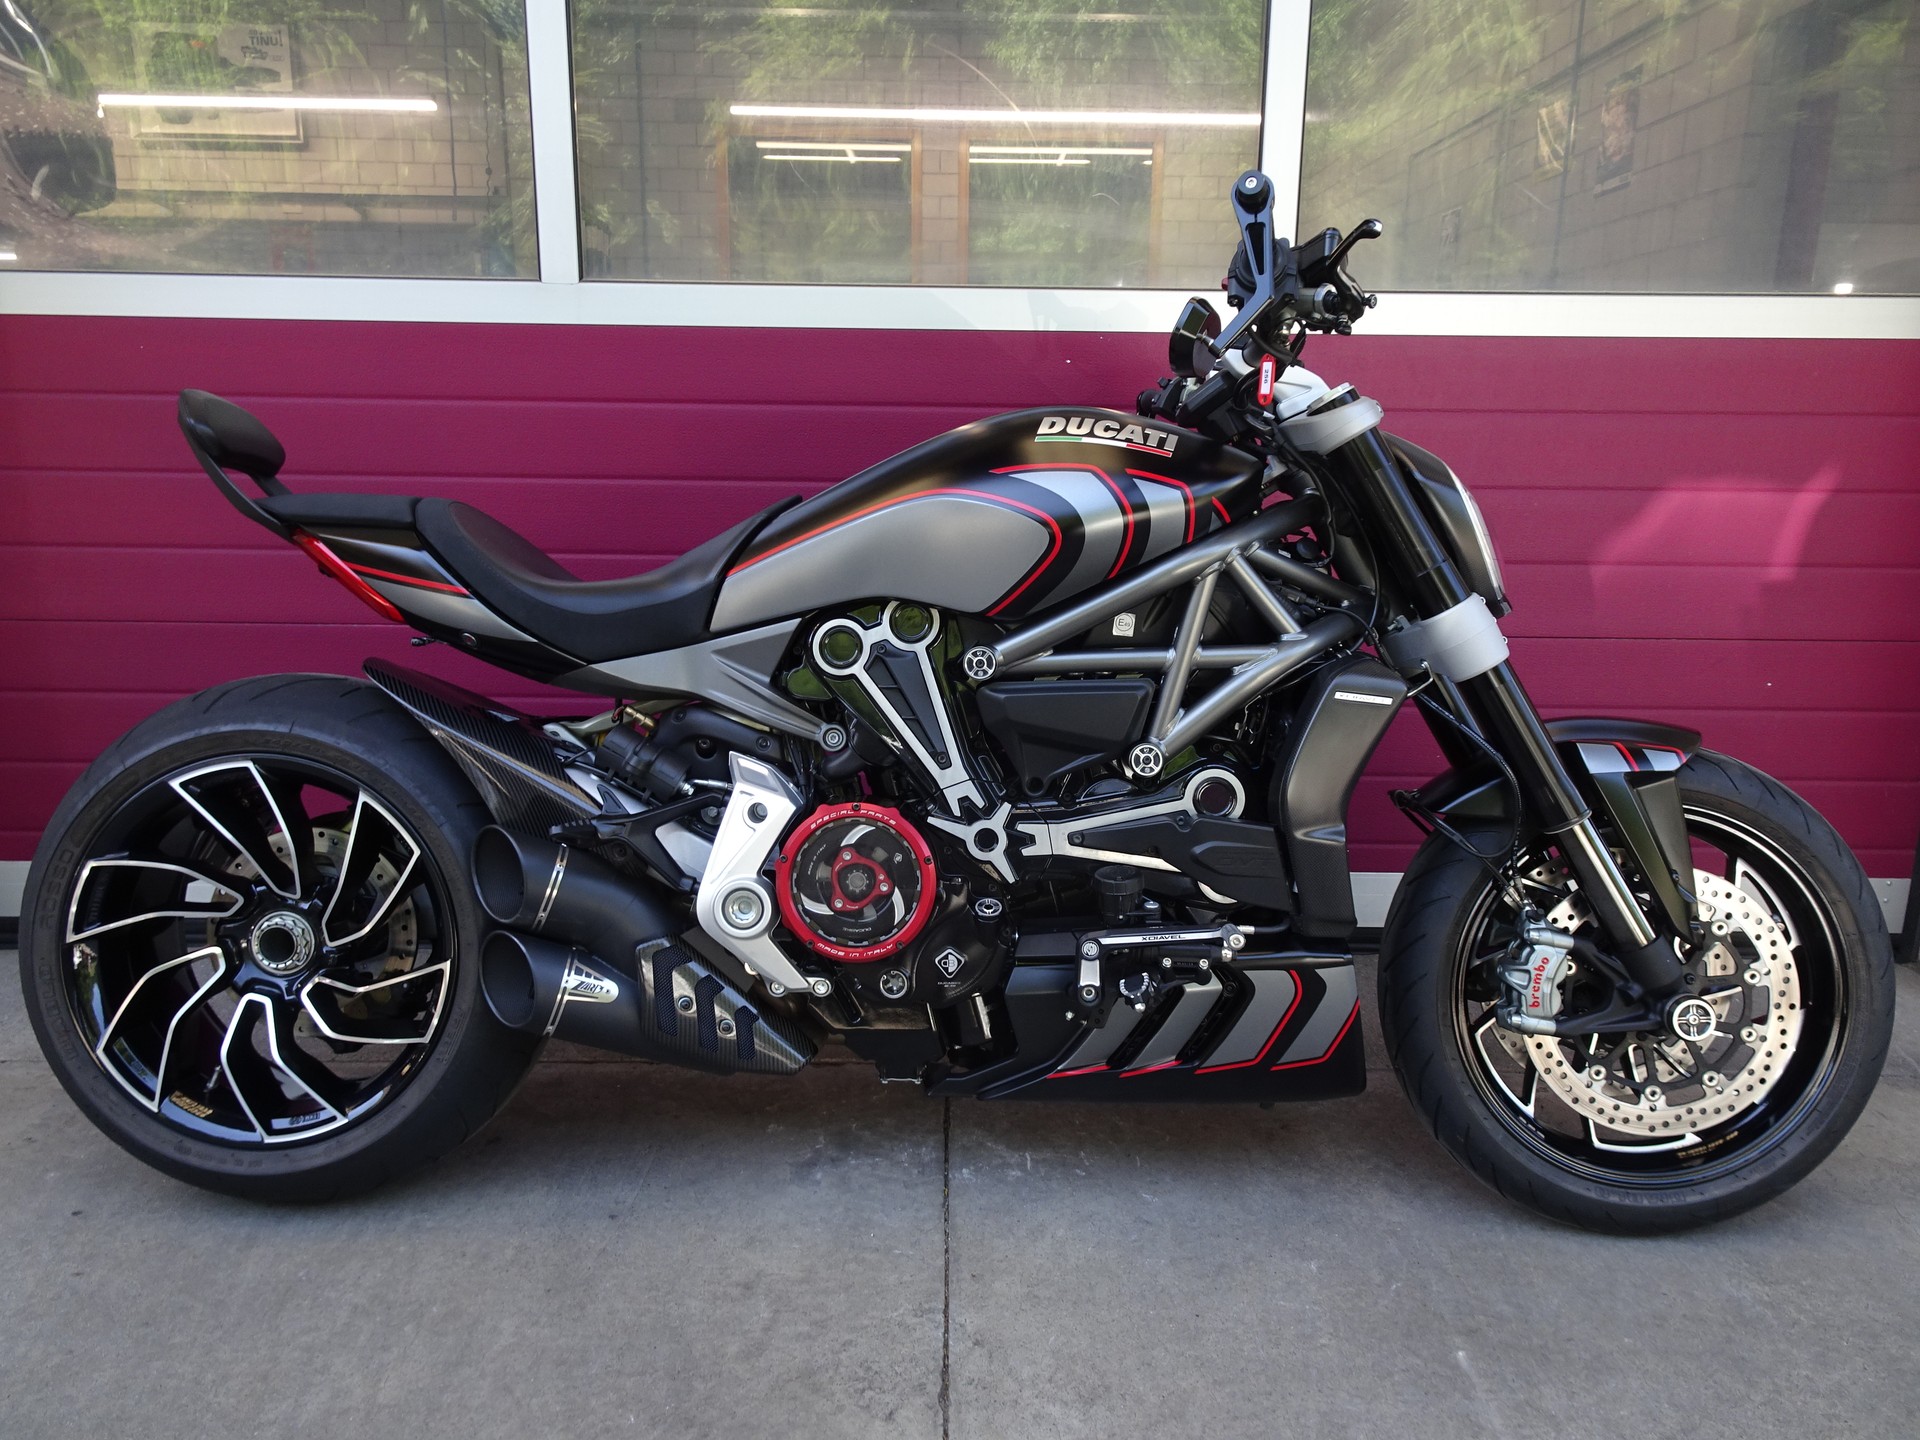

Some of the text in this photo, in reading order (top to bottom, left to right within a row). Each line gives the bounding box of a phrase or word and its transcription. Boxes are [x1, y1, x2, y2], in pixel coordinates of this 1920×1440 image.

[1036, 416, 1179, 452] DUCATI
[810, 809, 897, 830] SPECIAL PARTS
[817, 942, 845, 957] MADE
[863, 943, 894, 957] ITALY
[1529, 956, 1550, 1009] brembo
